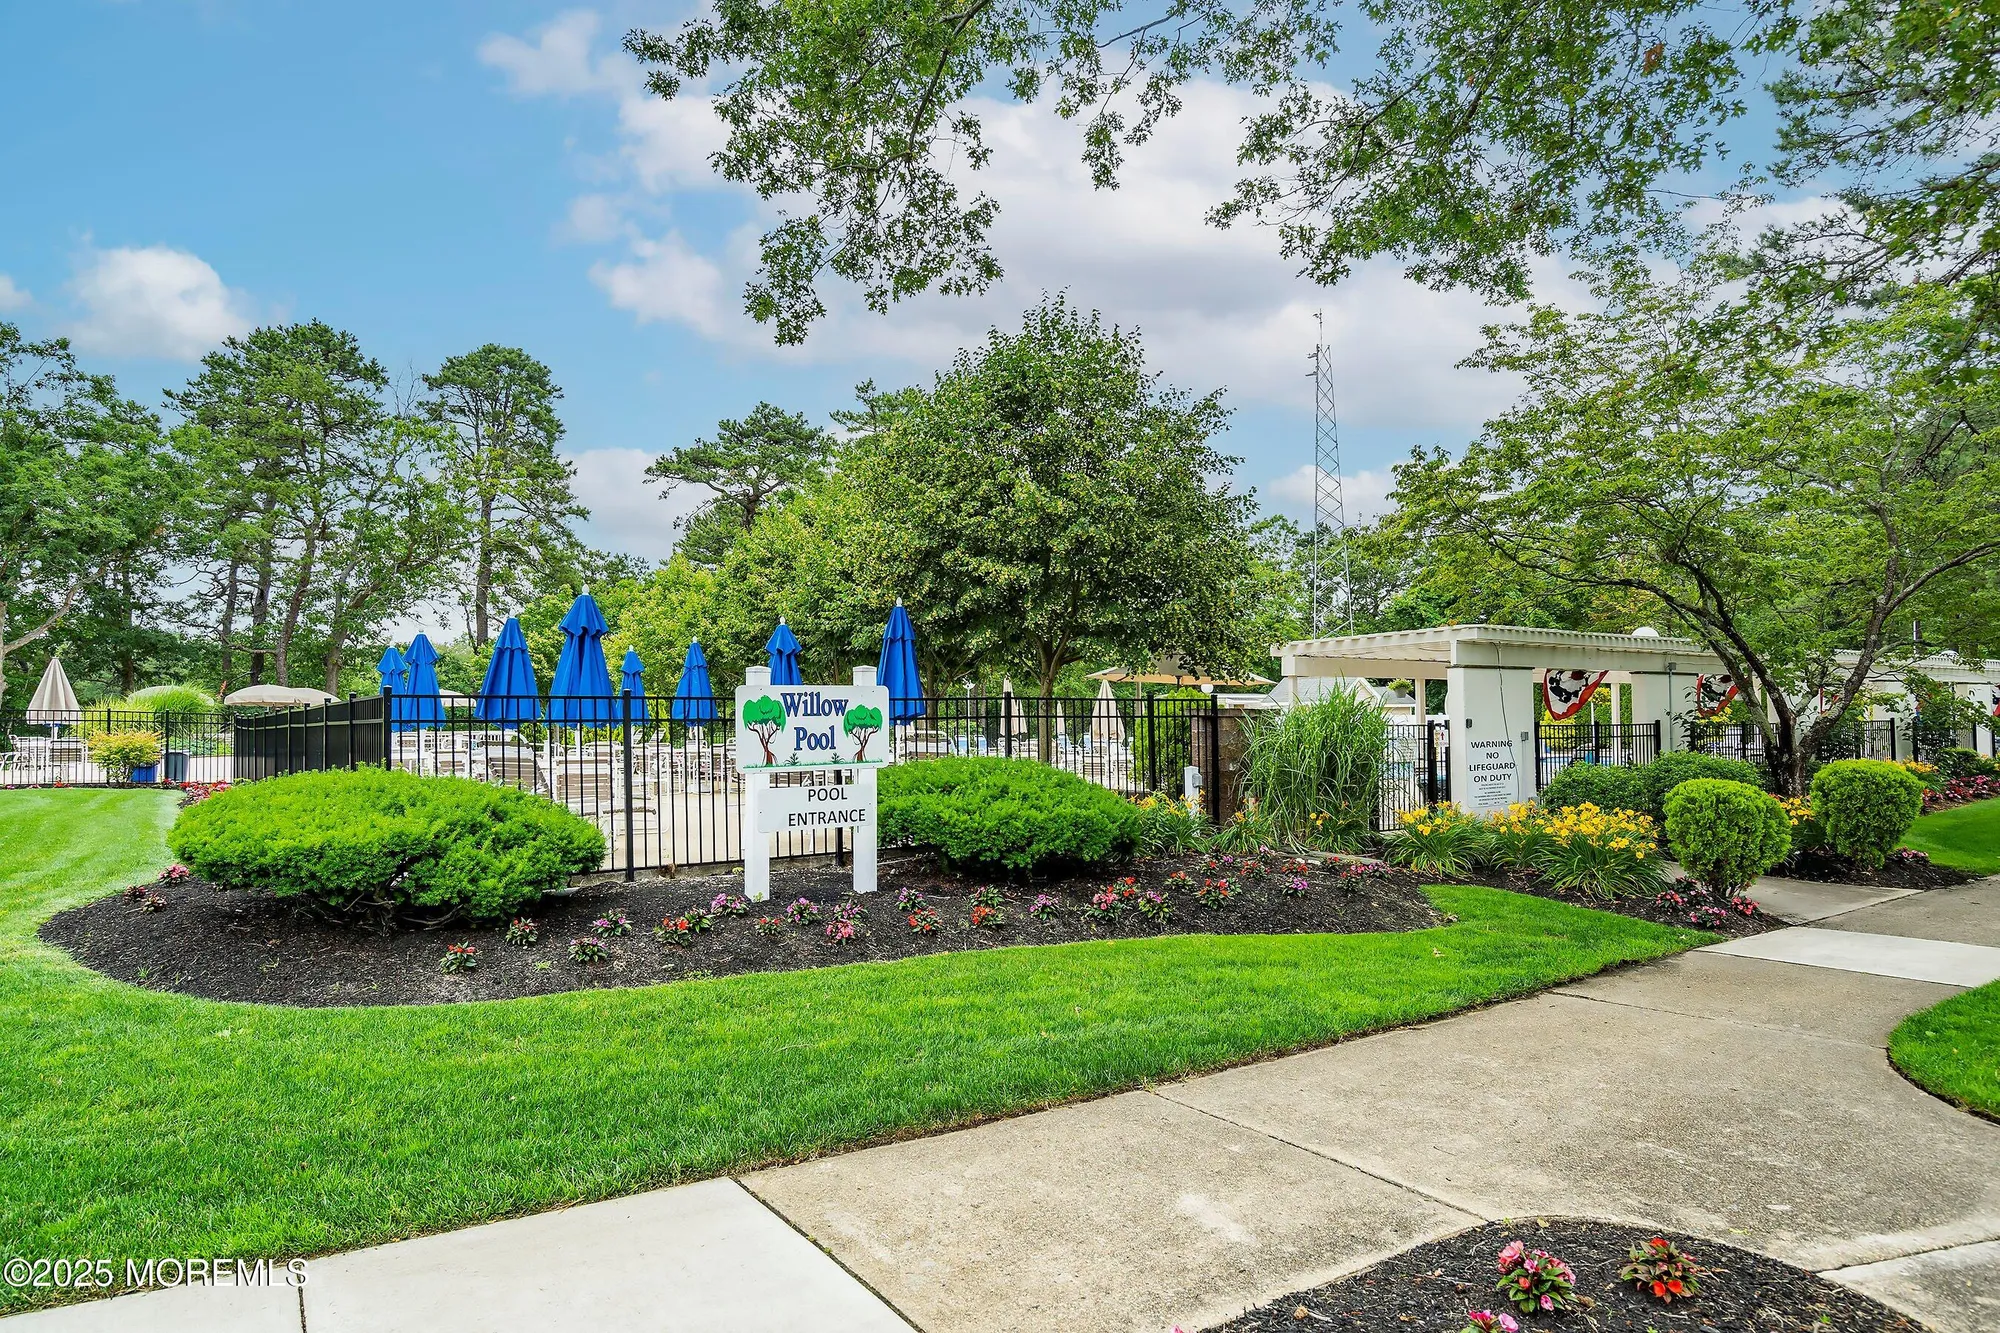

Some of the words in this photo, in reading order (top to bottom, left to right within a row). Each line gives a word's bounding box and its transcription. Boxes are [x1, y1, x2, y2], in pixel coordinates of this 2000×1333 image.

[780, 692, 849, 717] Willow
[793, 726, 837, 751] Pool
[1470, 740, 1513, 749] WARNING
[1469, 762, 1516, 772] LIFEGUARD
[1473, 775, 1487, 783] ON
[1490, 774, 1512, 782] DUTY
[808, 787, 848, 802] POOL
[788, 809, 866, 827] ENTRANCE
